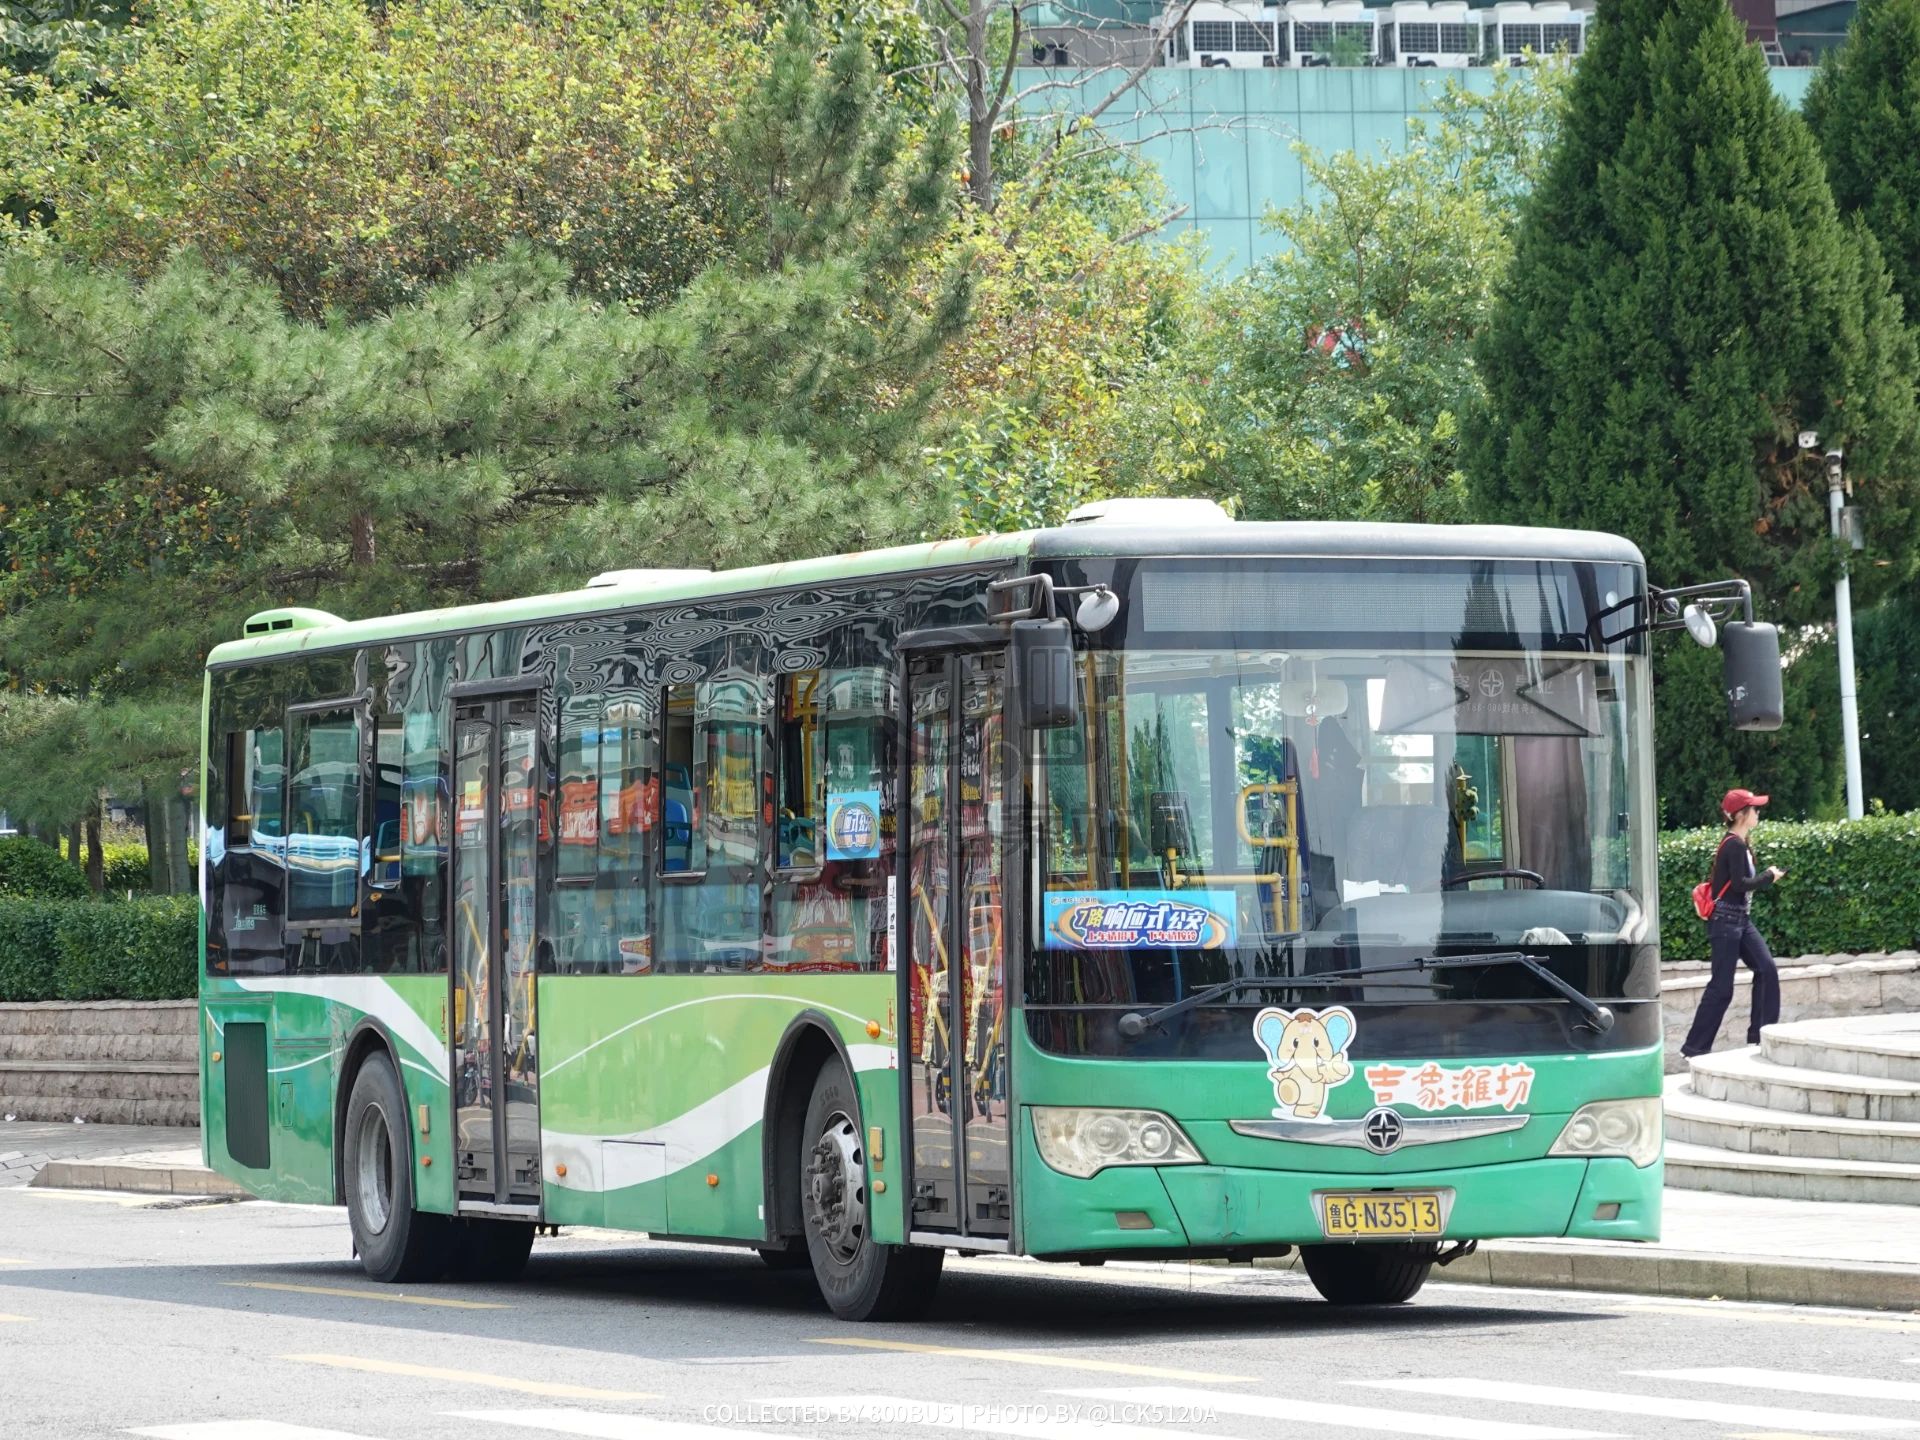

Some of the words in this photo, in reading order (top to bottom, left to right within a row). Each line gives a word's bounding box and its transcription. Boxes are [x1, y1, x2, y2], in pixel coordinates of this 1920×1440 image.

[1079, 906, 1206, 930] 7路响应式公交
